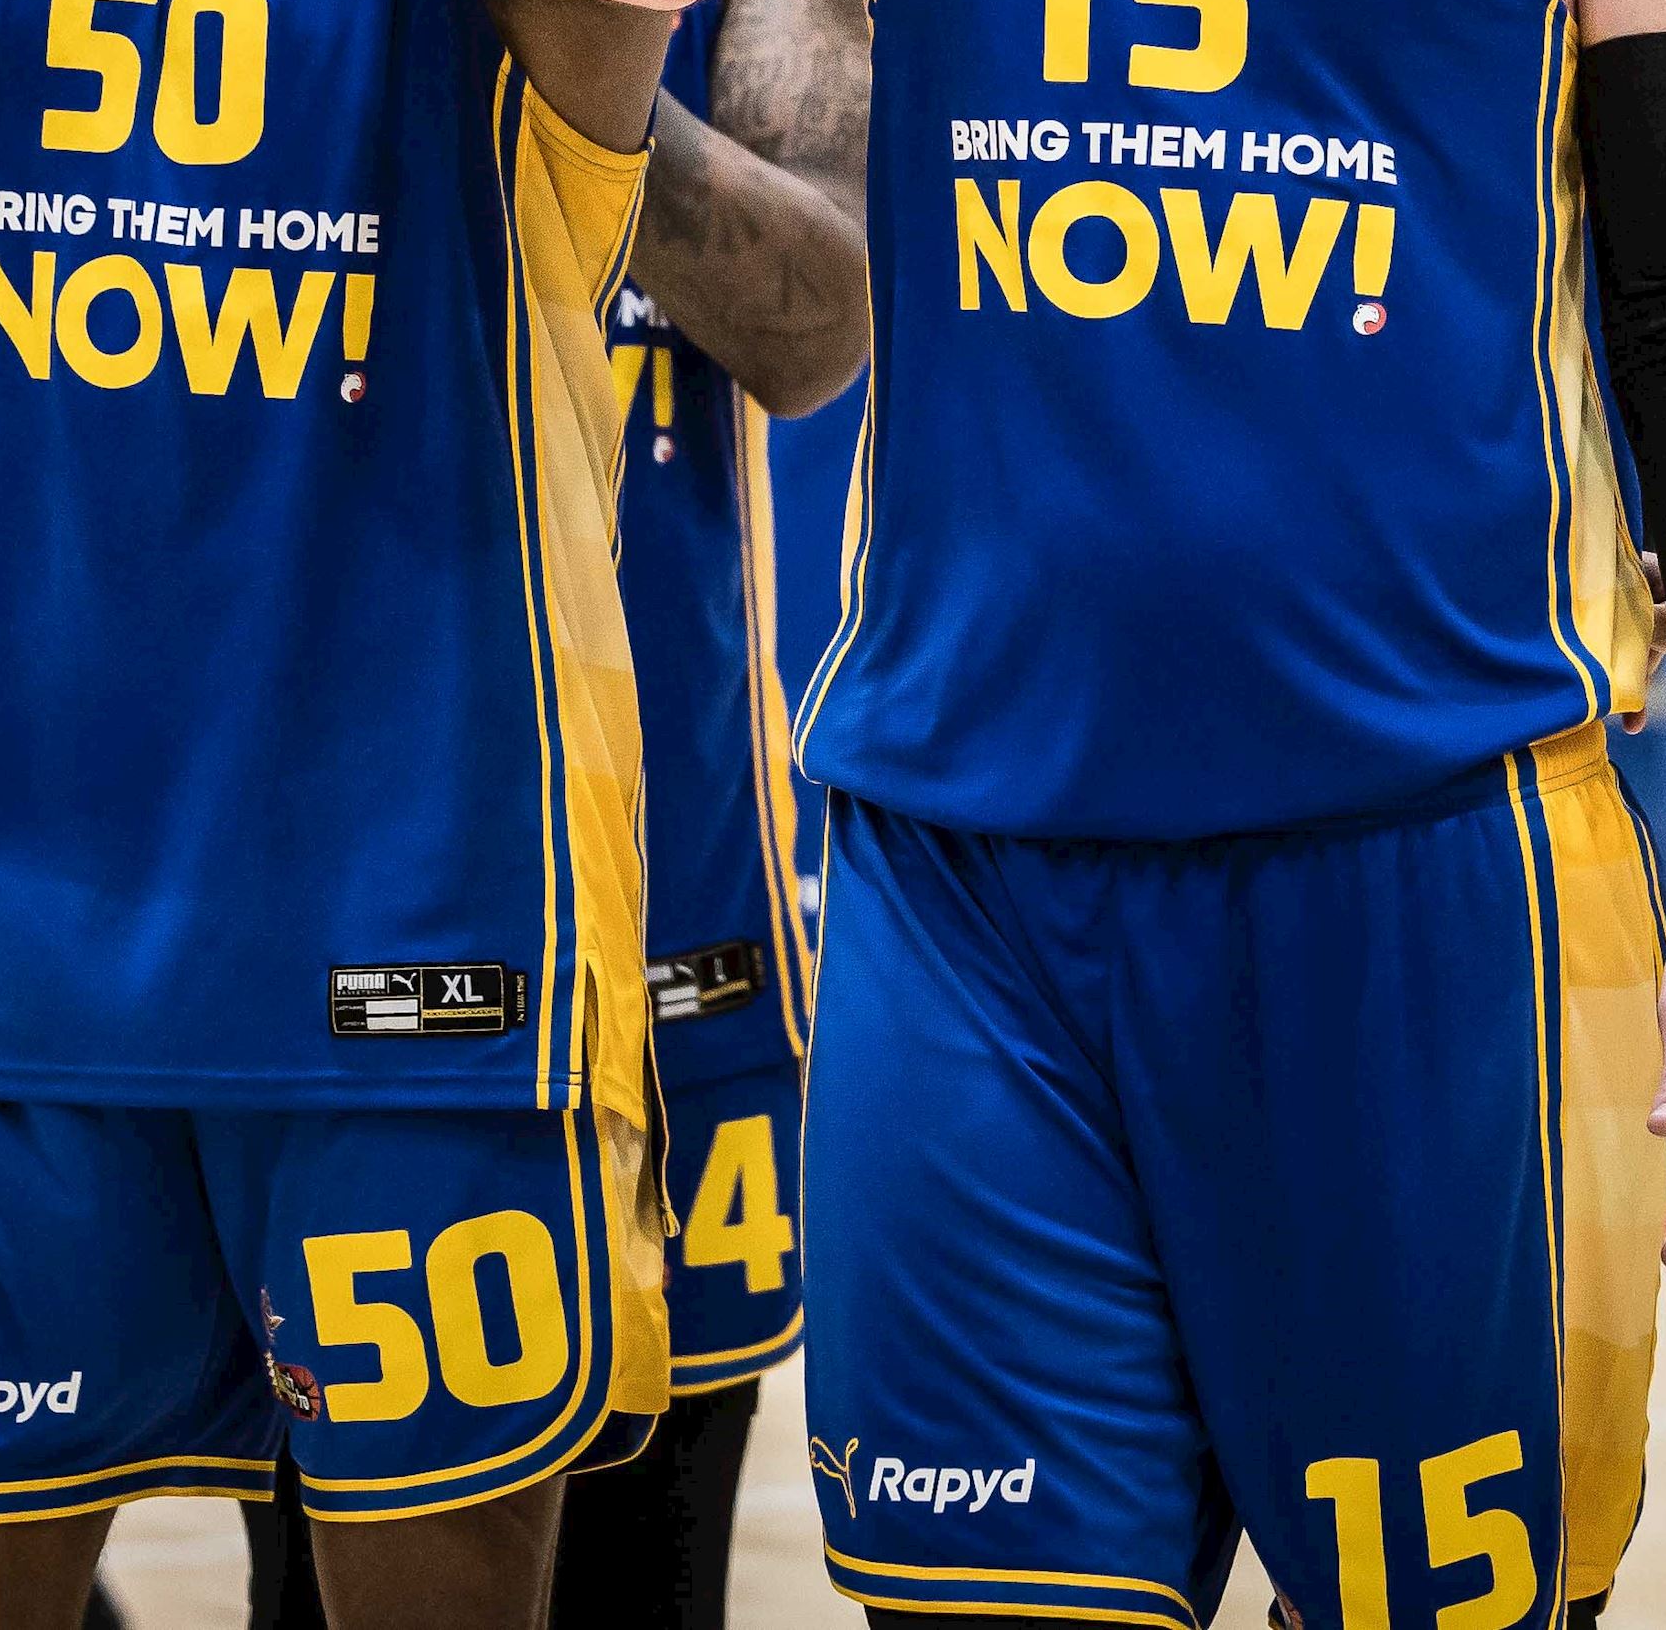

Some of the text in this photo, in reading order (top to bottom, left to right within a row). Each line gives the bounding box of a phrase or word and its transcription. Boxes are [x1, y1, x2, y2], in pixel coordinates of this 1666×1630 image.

[950, 119, 1399, 186] BRING THEM HOME
[107, 197, 225, 249] THEM
[237, 207, 381, 254] HOME
[954, 178, 1397, 337] NOW!
[336, 973, 386, 991] PUMA
[440, 974, 484, 1004] XL
[683, 1114, 795, 1294] 4
[302, 1209, 569, 1423] 50
[868, 1457, 1037, 1514] Rapyd
[1305, 1429, 1539, 1630] 15
